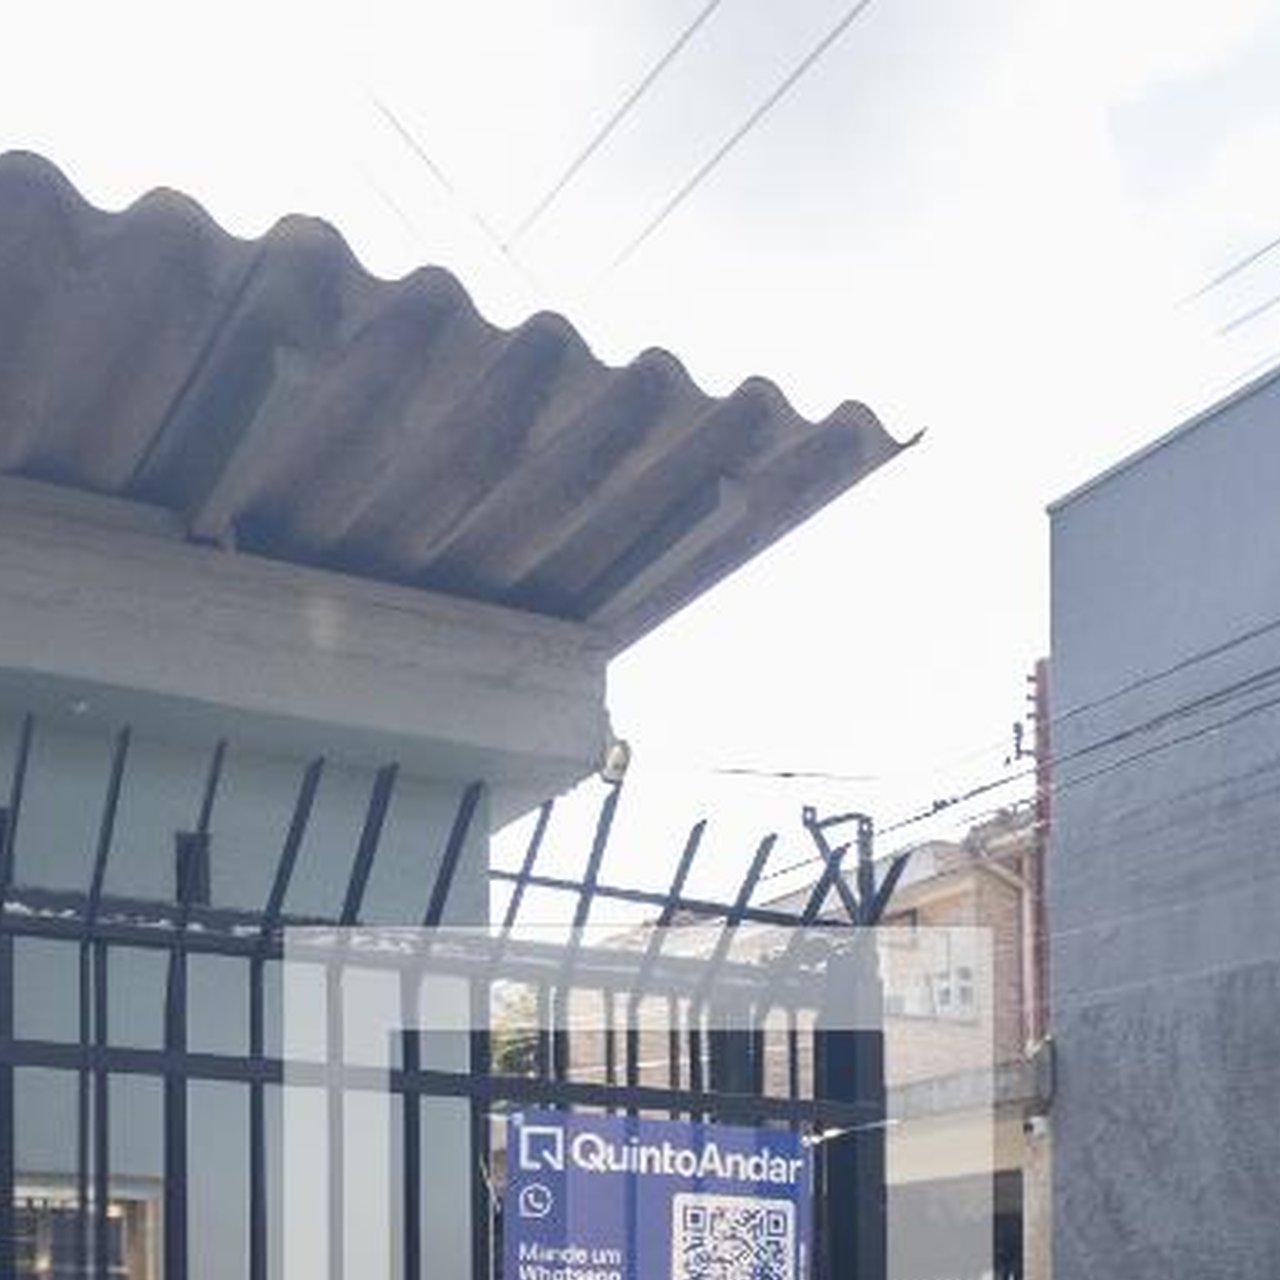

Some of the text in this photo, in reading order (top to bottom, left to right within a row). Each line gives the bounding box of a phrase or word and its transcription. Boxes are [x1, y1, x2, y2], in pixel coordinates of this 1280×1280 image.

[572, 1132, 804, 1184] QuintoAndar
[519, 1243, 621, 1265] Mande um
